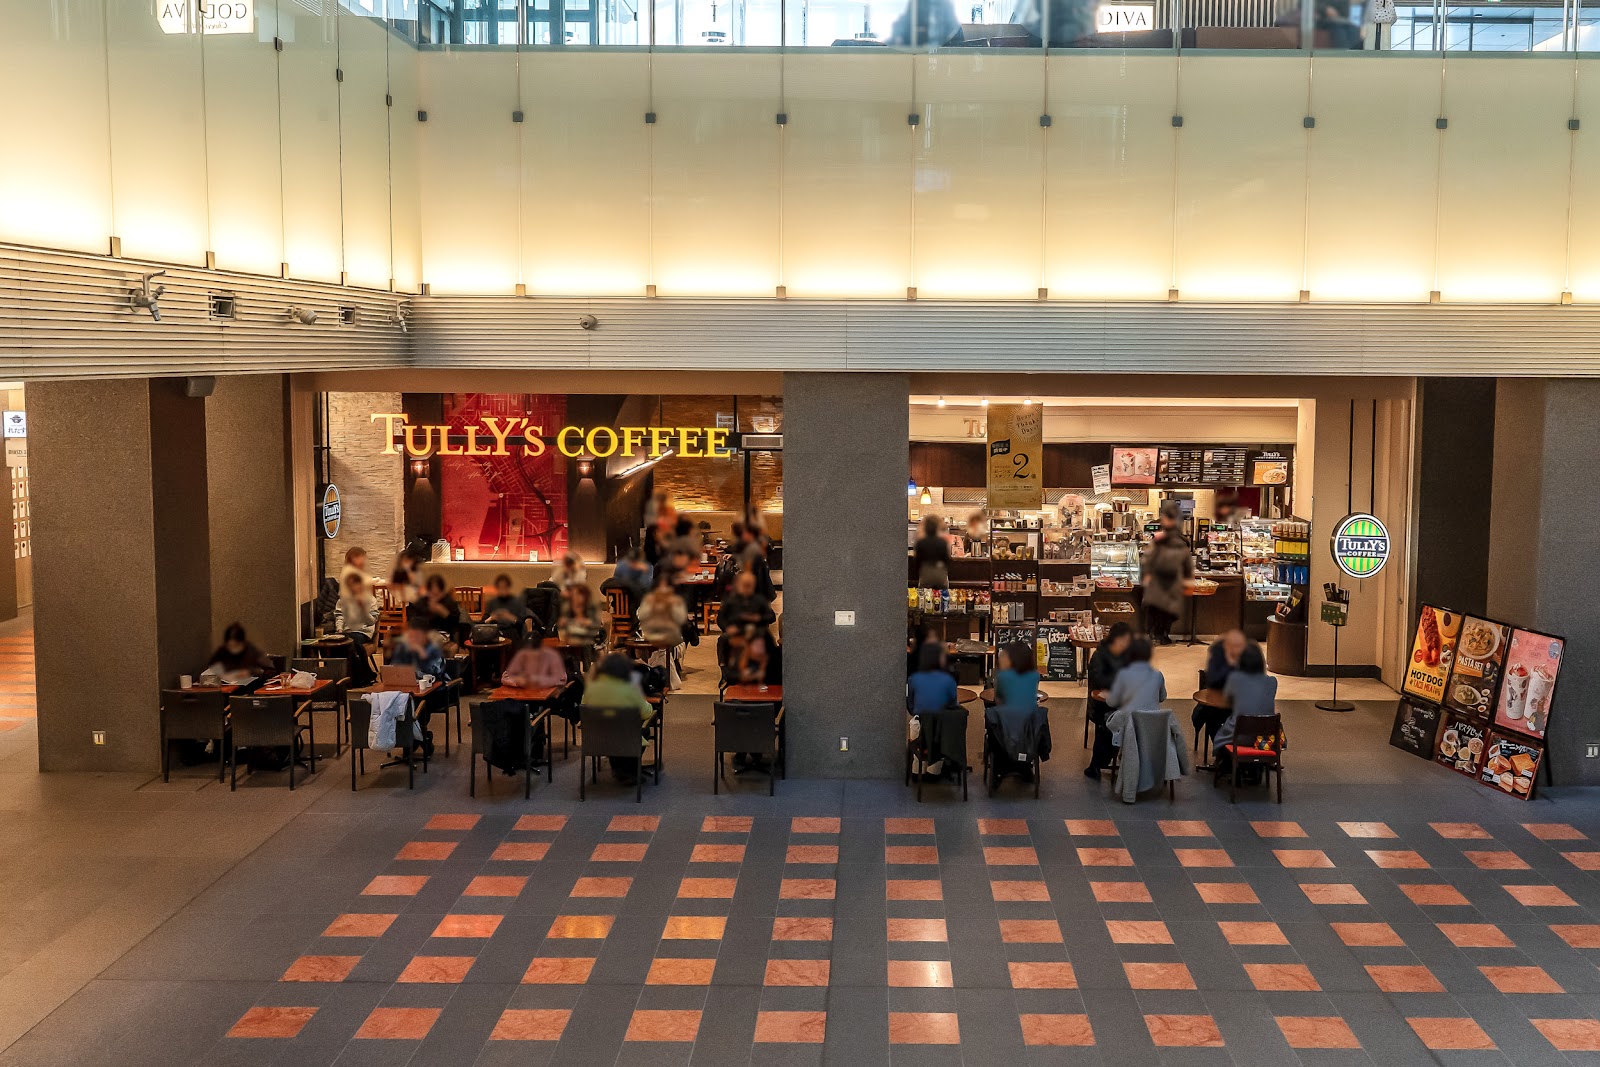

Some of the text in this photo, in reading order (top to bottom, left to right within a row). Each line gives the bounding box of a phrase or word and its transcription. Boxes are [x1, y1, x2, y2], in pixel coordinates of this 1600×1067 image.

[370, 413, 732, 459] TULLY'S COFFEE
[1013, 453, 1030, 479] 2
[1339, 538, 1386, 552] TULLY'S
[1458, 655, 1475, 669] PASTA
[1474, 661, 1484, 671] SET
[1410, 669, 1443, 687] HOT DOG
